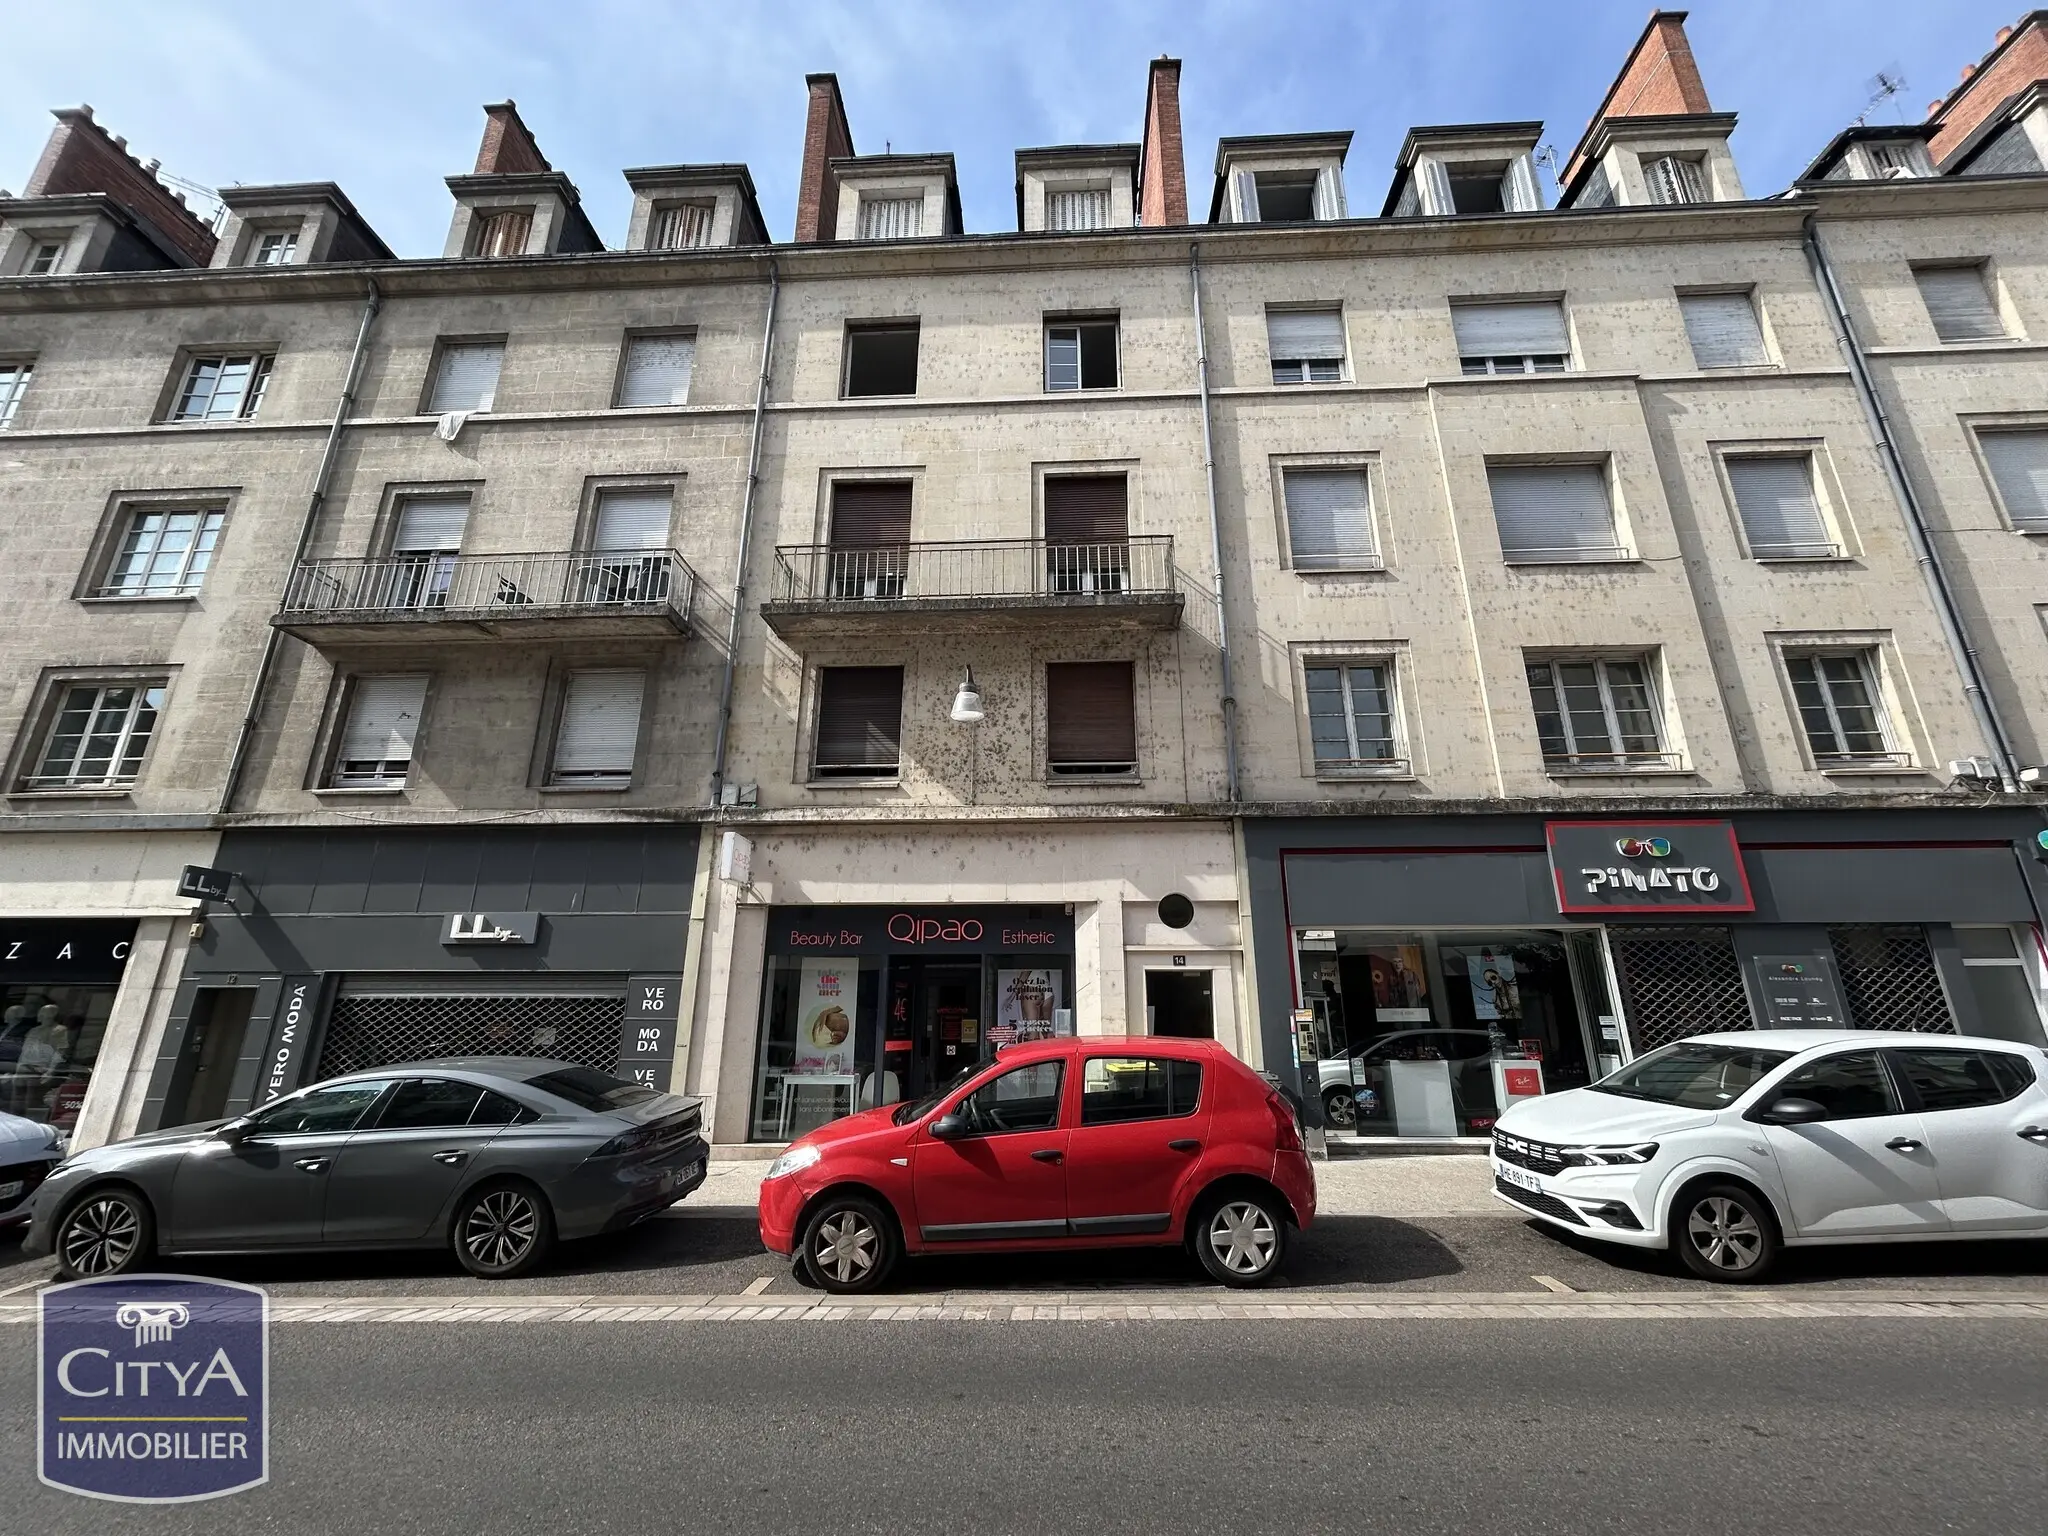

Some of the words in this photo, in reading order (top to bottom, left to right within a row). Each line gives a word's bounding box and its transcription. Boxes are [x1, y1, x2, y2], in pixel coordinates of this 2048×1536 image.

[790, 930, 836, 947] Beauty
[840, 930, 863, 945] Bar
[888, 913, 983, 944] Qipao
[1002, 929, 1055, 944] Esthetic
[1174, 956, 1184, 965] 14
[644, 987, 665, 998] VE
[642, 1000, 664, 1011] RO
[638, 1028, 660, 1039] MO
[266, 1048, 290, 1102] VERO
[281, 985, 307, 1043] MODA
[636, 1041, 658, 1052] DA
[634, 1069, 655, 1081] VE
